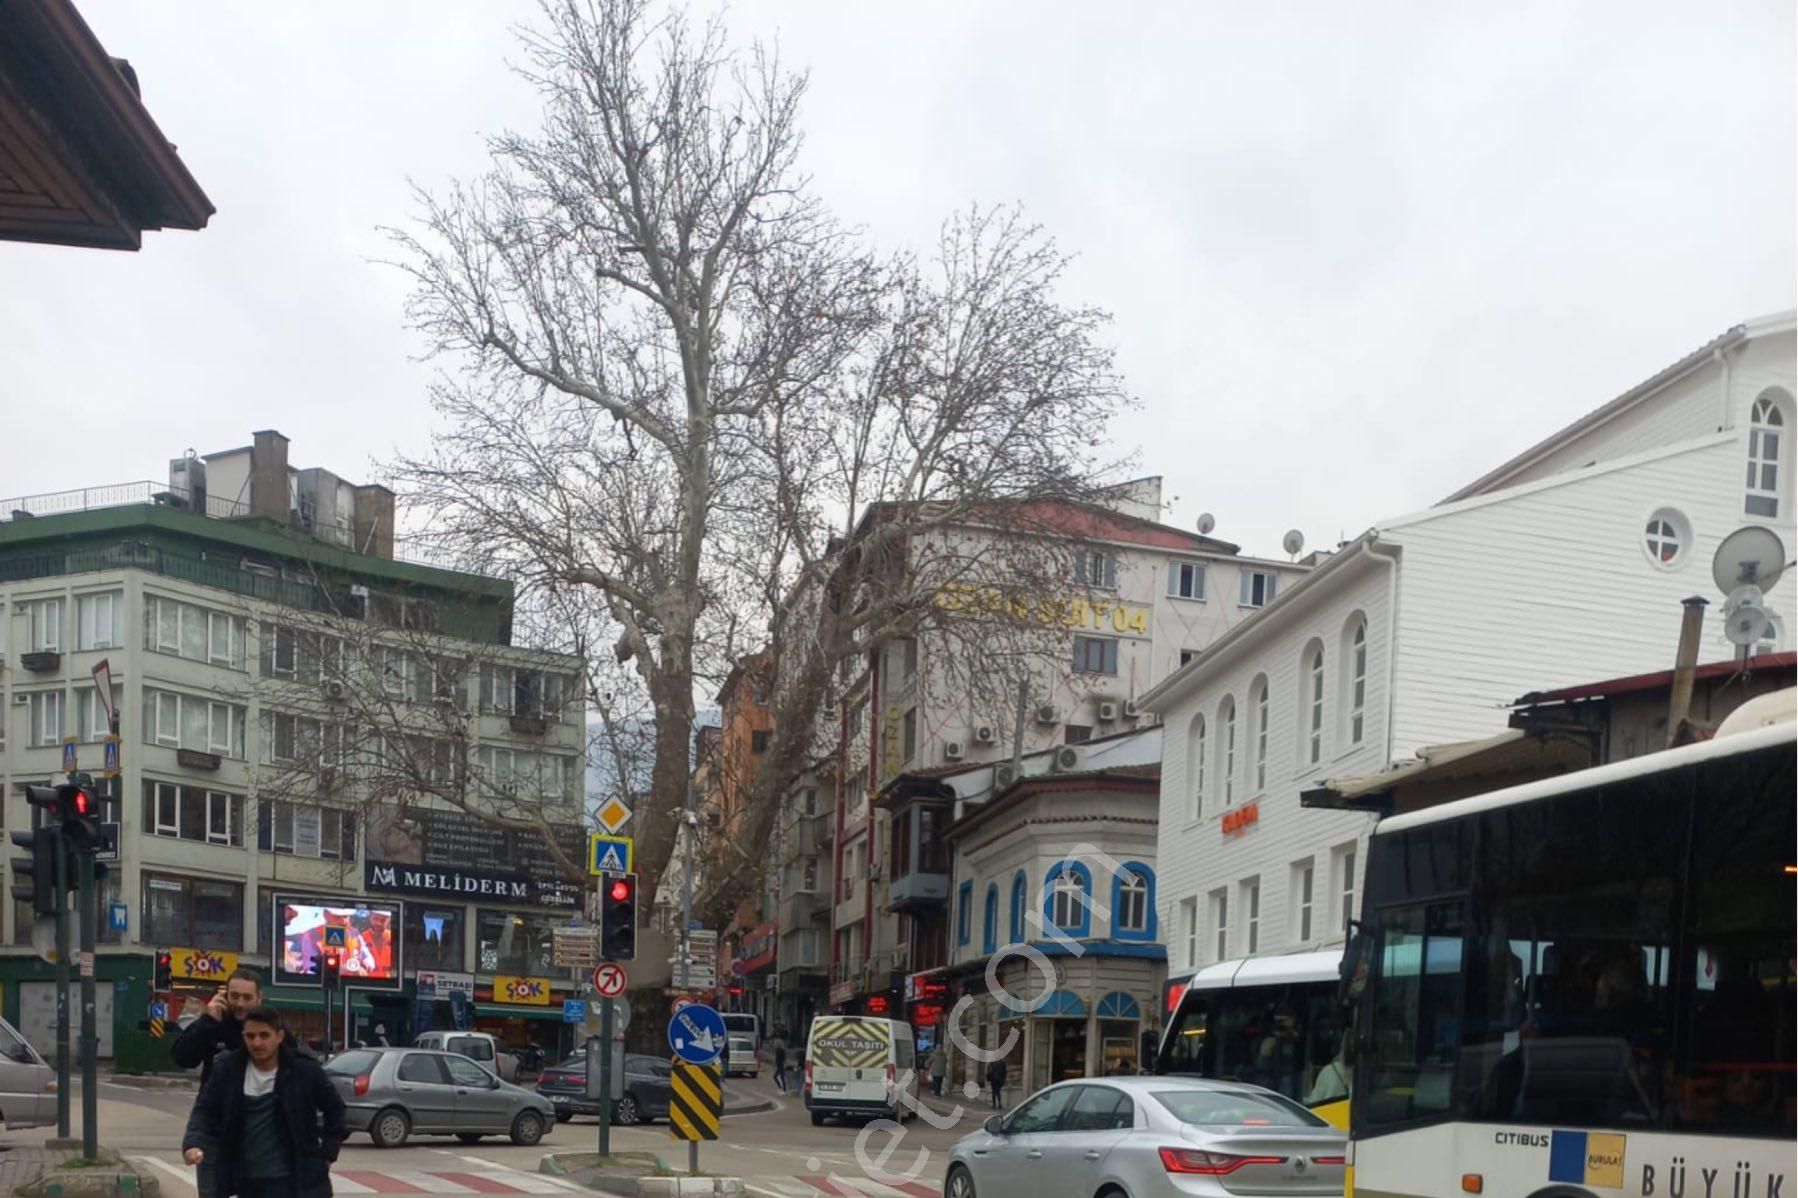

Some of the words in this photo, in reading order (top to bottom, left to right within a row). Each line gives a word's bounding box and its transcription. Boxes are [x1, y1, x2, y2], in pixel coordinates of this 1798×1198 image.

[1113, 604, 1147, 636] 04
[404, 872, 528, 898] MELİDERM
[184, 955, 226, 977] ŞOK
[506, 981, 544, 999] ŞOK
[818, 1039, 848, 1047] OKUL
[851, 1041, 884, 1050] TAŞITI
[1495, 1132, 1550, 1147] CITIBUS
